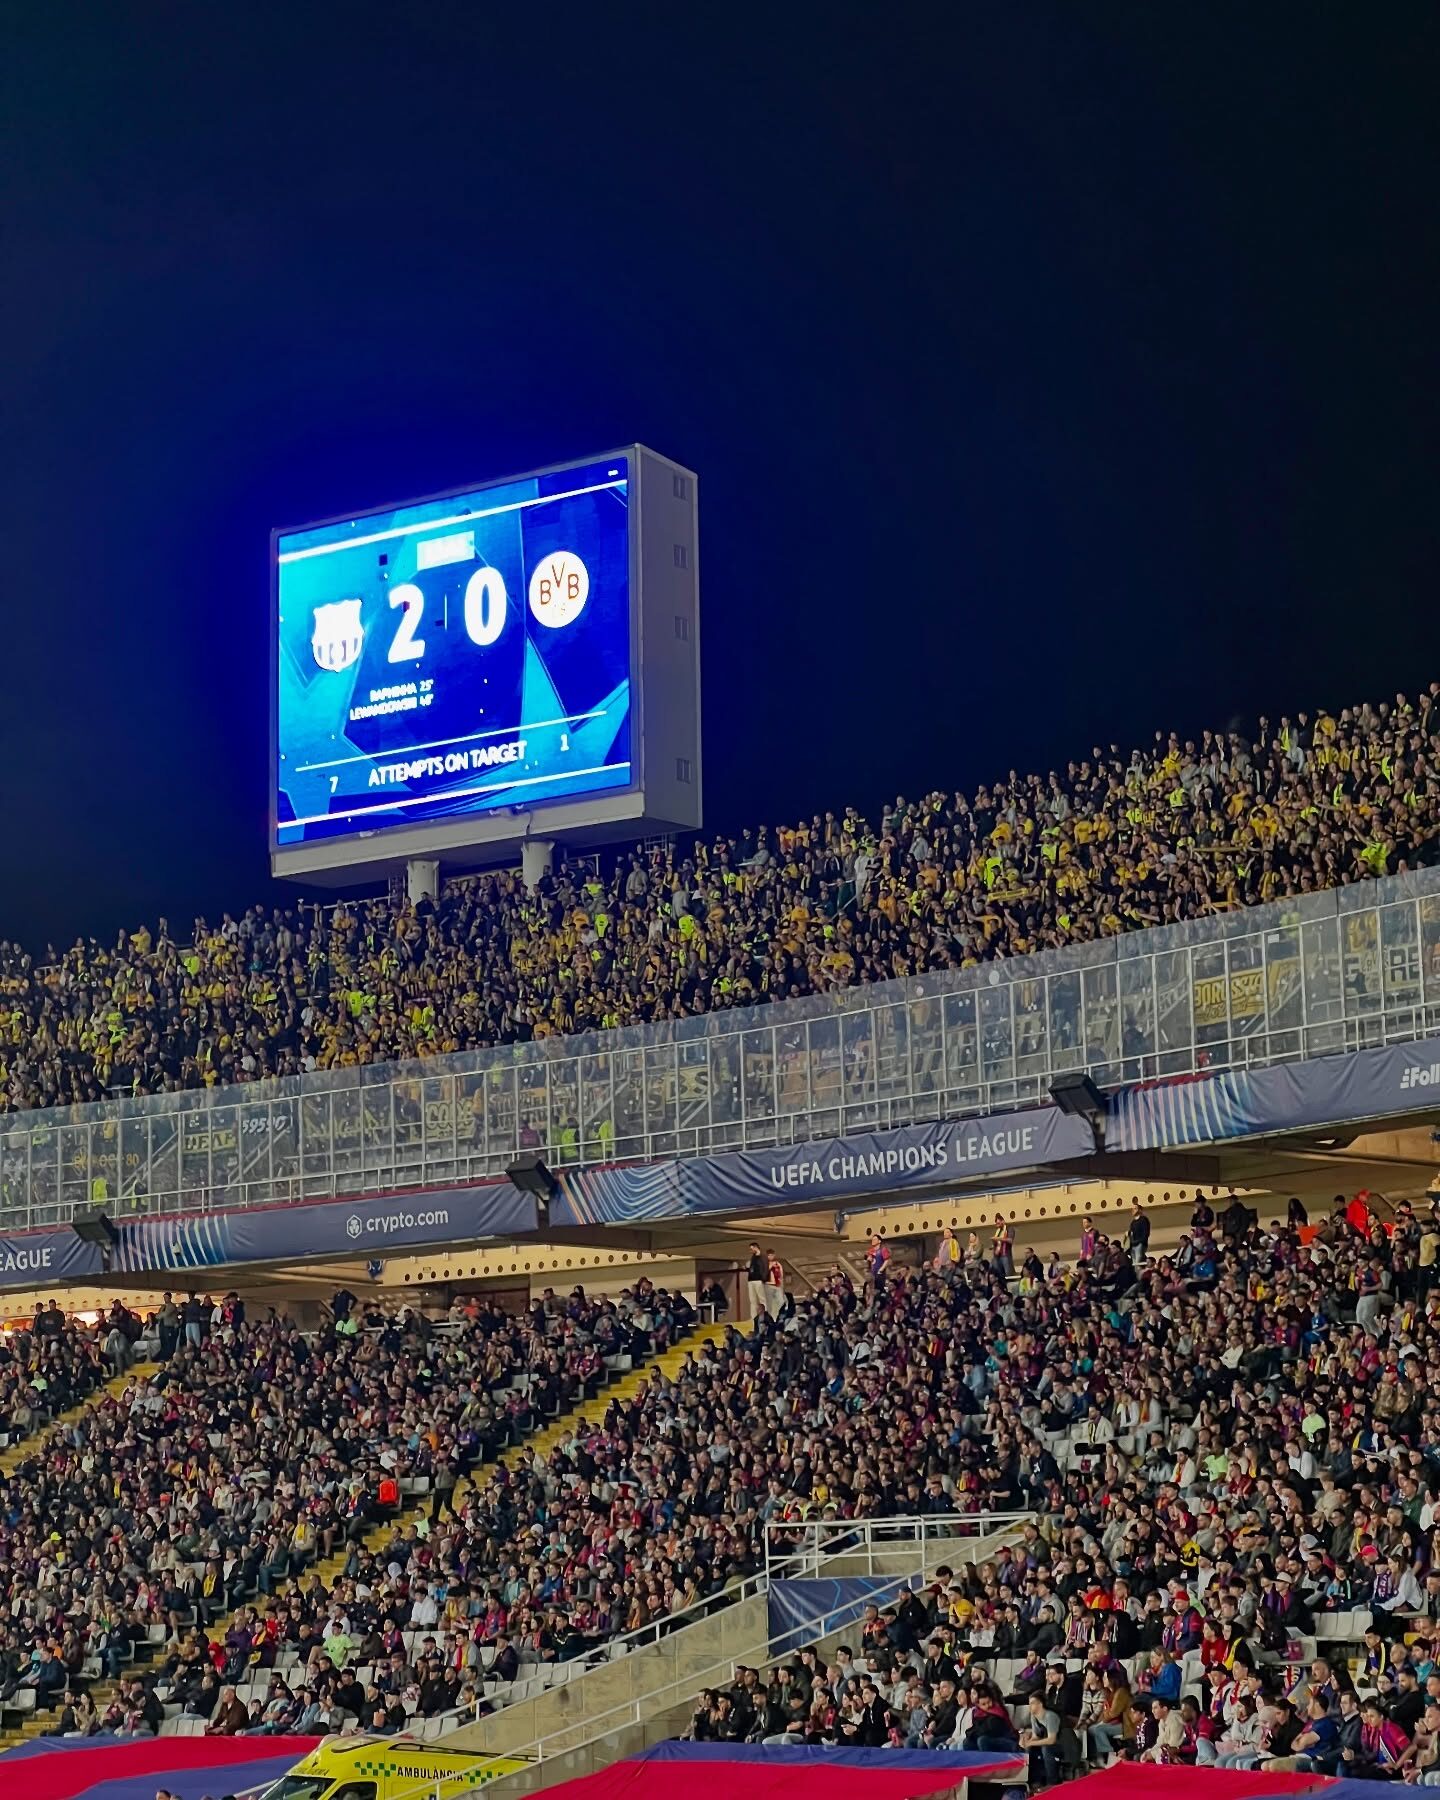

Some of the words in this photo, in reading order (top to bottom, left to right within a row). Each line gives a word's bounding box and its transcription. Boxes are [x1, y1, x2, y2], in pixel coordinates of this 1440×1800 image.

[540, 561, 579, 605] BVB
[388, 583, 426, 664] 2
[465, 566, 507, 646] 0
[329, 776, 338, 793] 7
[368, 757, 443, 787] ATTEMPTS
[443, 752, 468, 773] ON
[472, 740, 527, 769] TARGET
[560, 734, 569, 752] 1
[771, 1162, 824, 1188] UEFA
[828, 1142, 947, 1181] CHAMPIONS
[955, 1128, 1033, 1162] LEAGUE
[366, 1210, 449, 1233] crypto.com
